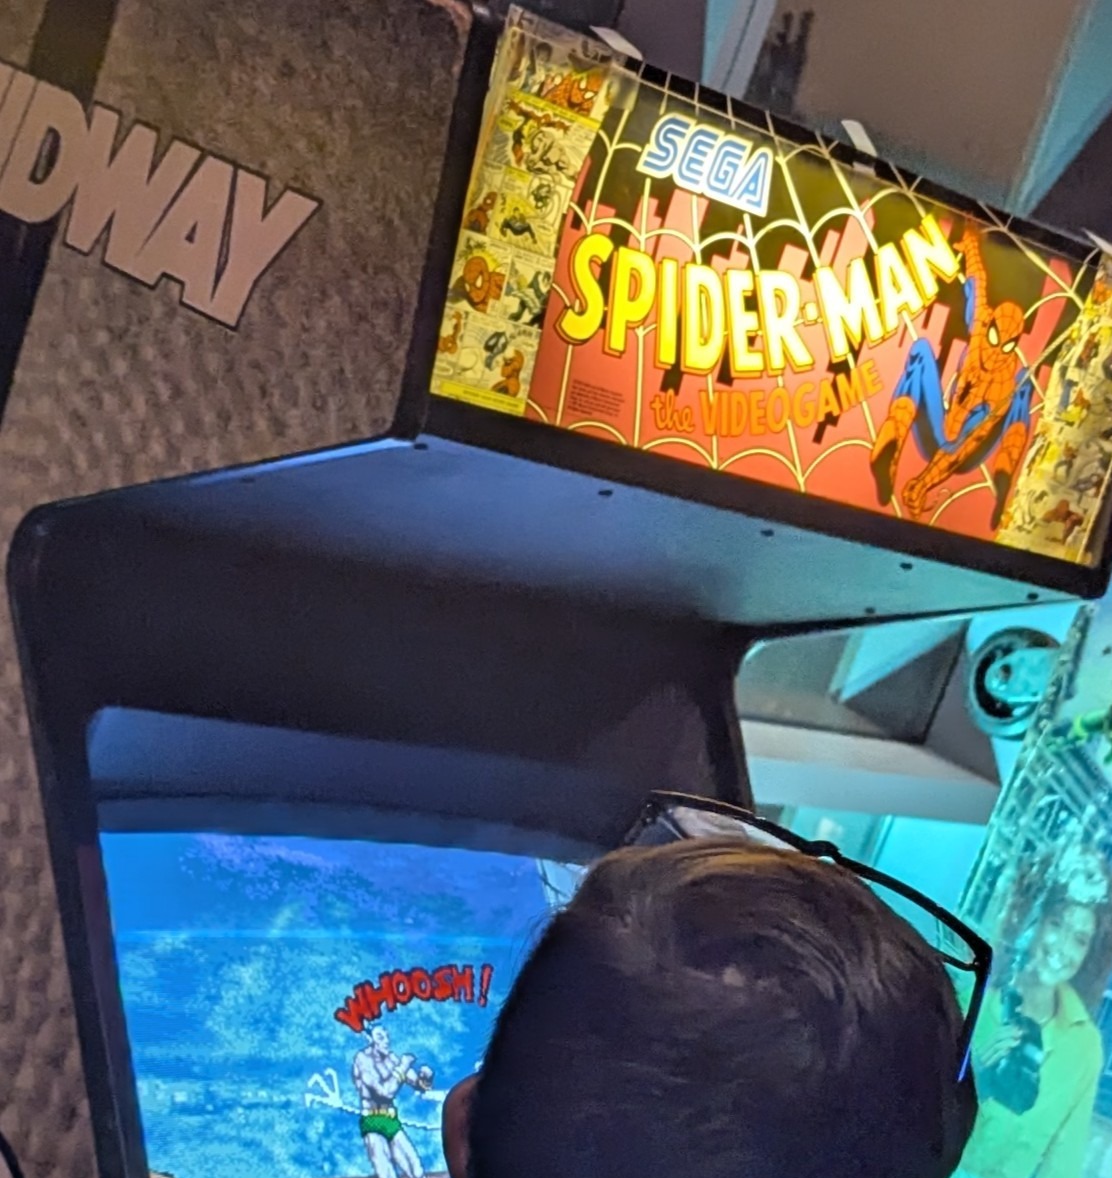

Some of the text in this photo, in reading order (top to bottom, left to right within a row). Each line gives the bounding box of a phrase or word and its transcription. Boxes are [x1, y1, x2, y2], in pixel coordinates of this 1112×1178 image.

[639, 114, 772, 214] SEGA
[650, 387, 696, 433] the
[335, 963, 494, 1033] WHOOSH!
